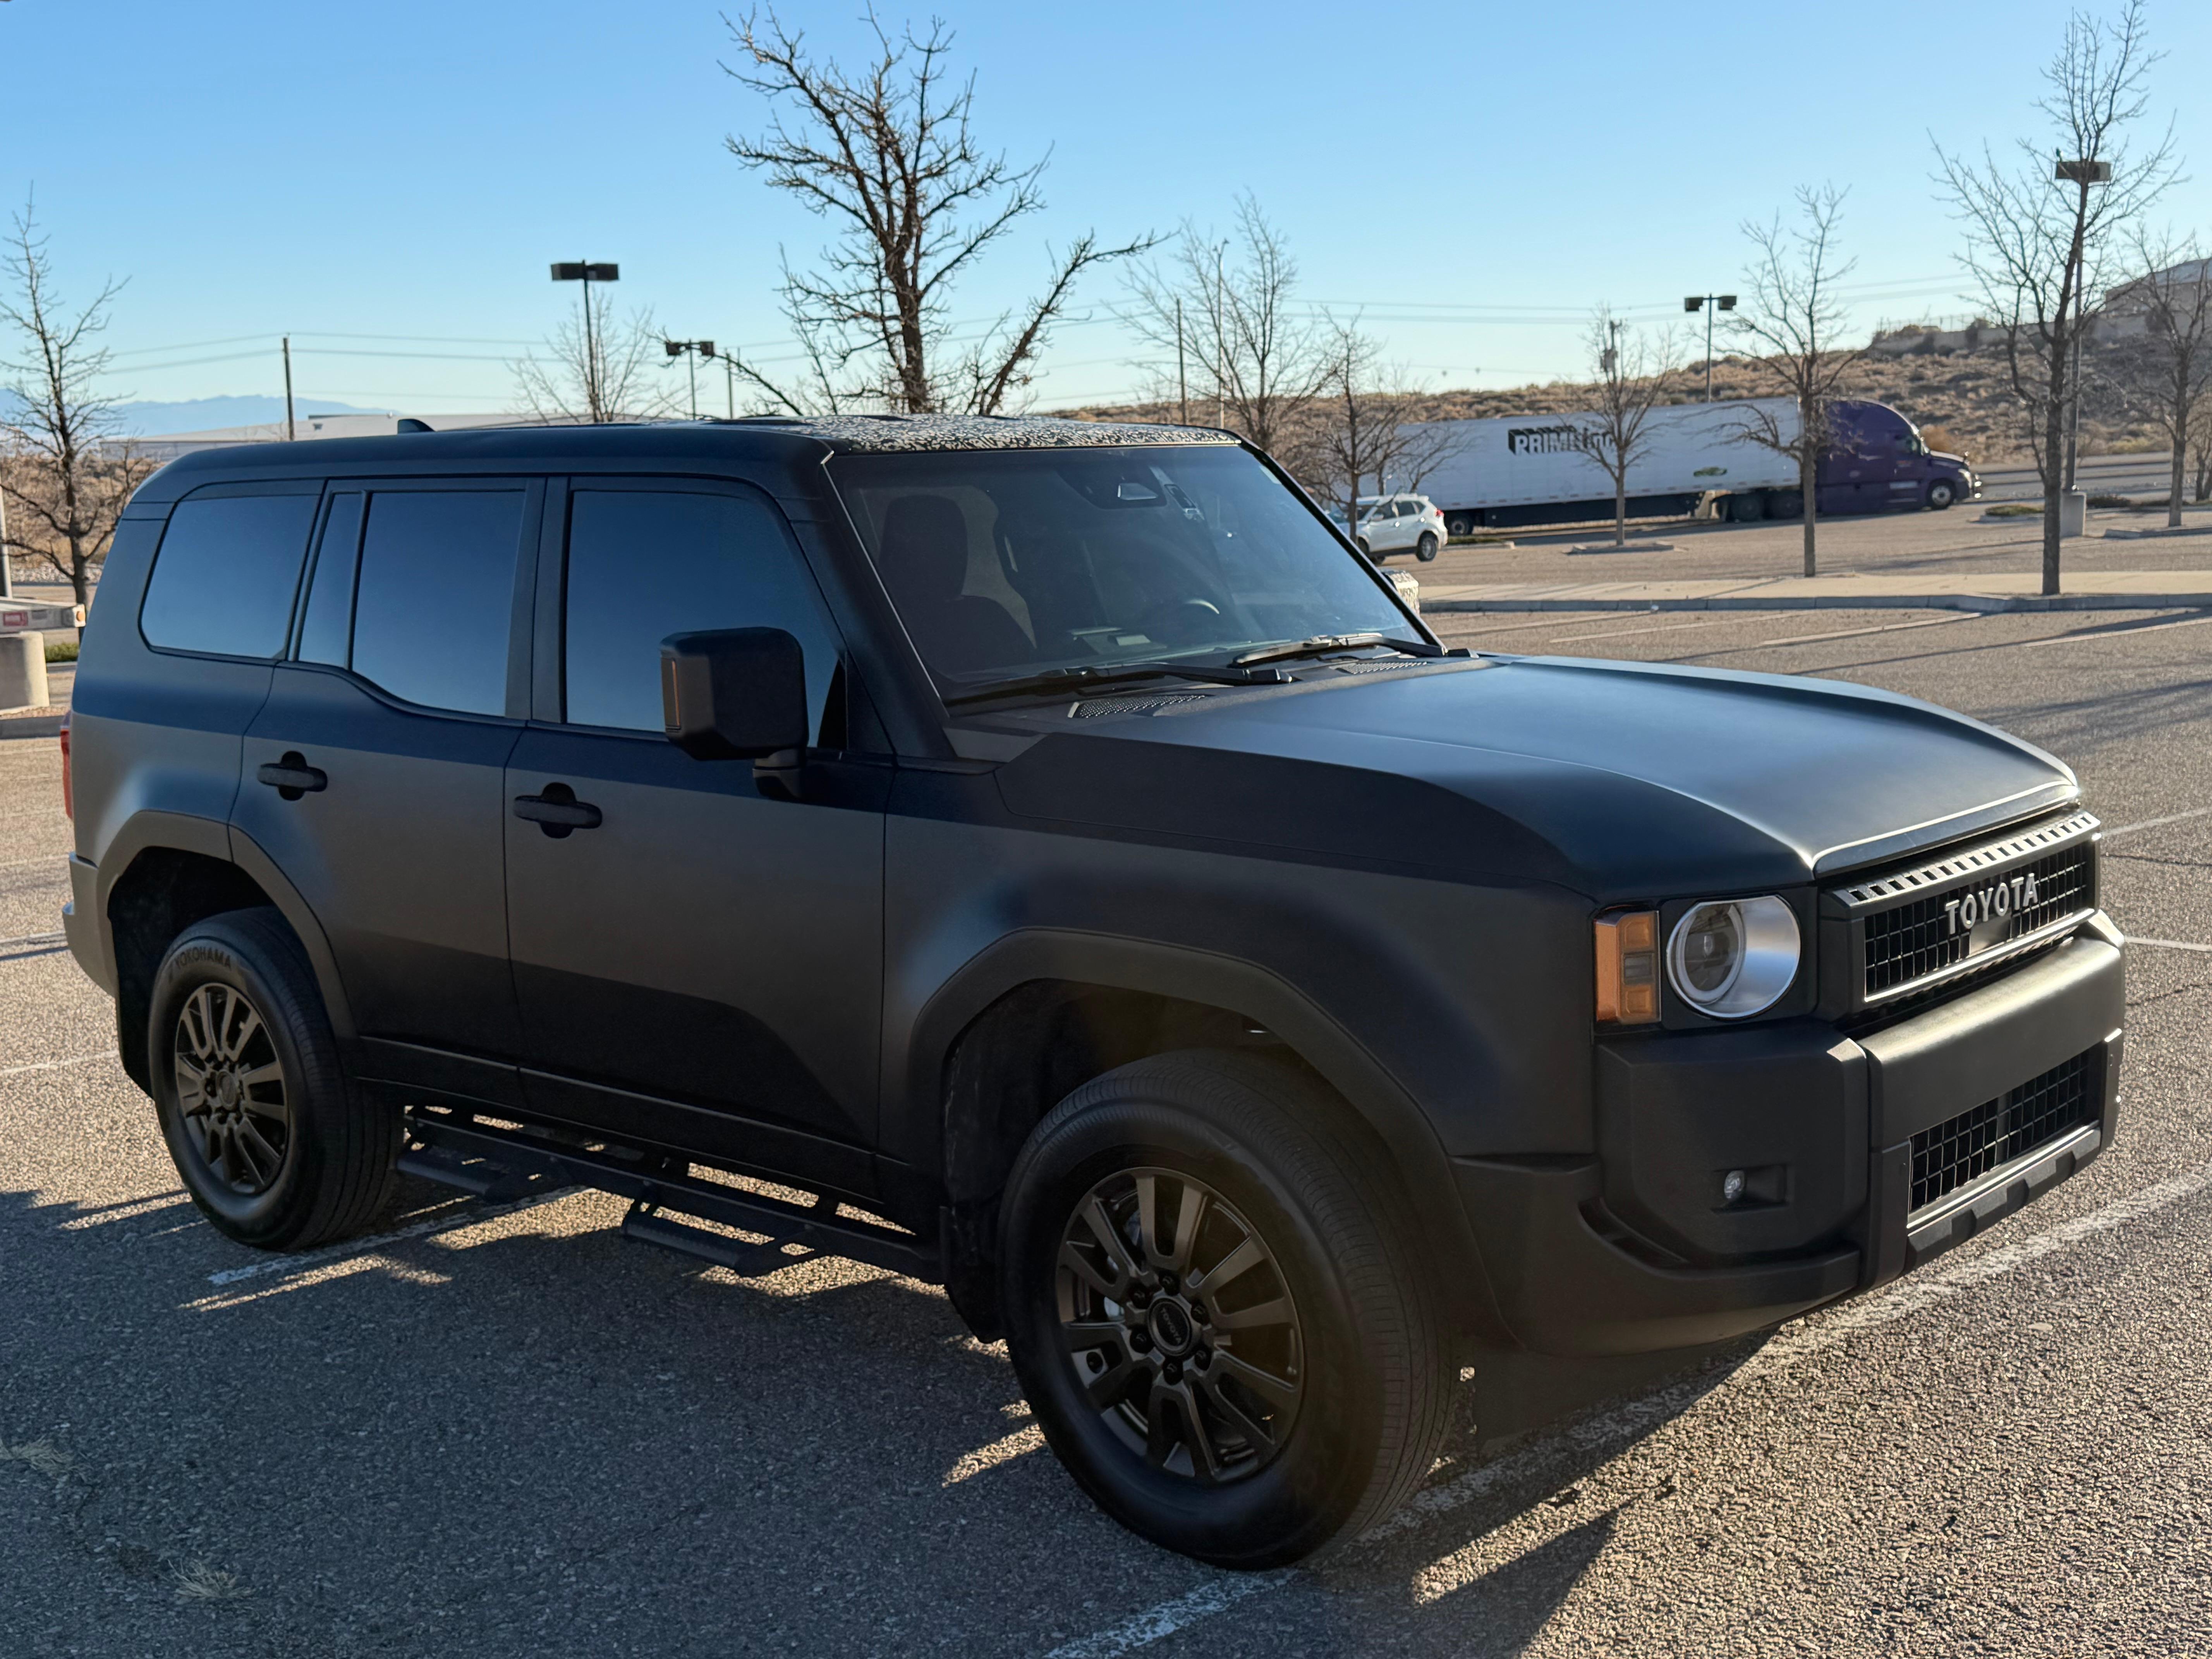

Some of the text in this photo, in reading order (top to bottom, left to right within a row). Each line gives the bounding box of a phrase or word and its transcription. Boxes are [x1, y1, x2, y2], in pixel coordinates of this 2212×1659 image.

[1945, 872, 2038, 935] TOYOTA
[175, 946, 232, 971] YOKOHAMA
[1160, 1307, 1182, 1344] TOYOTA
